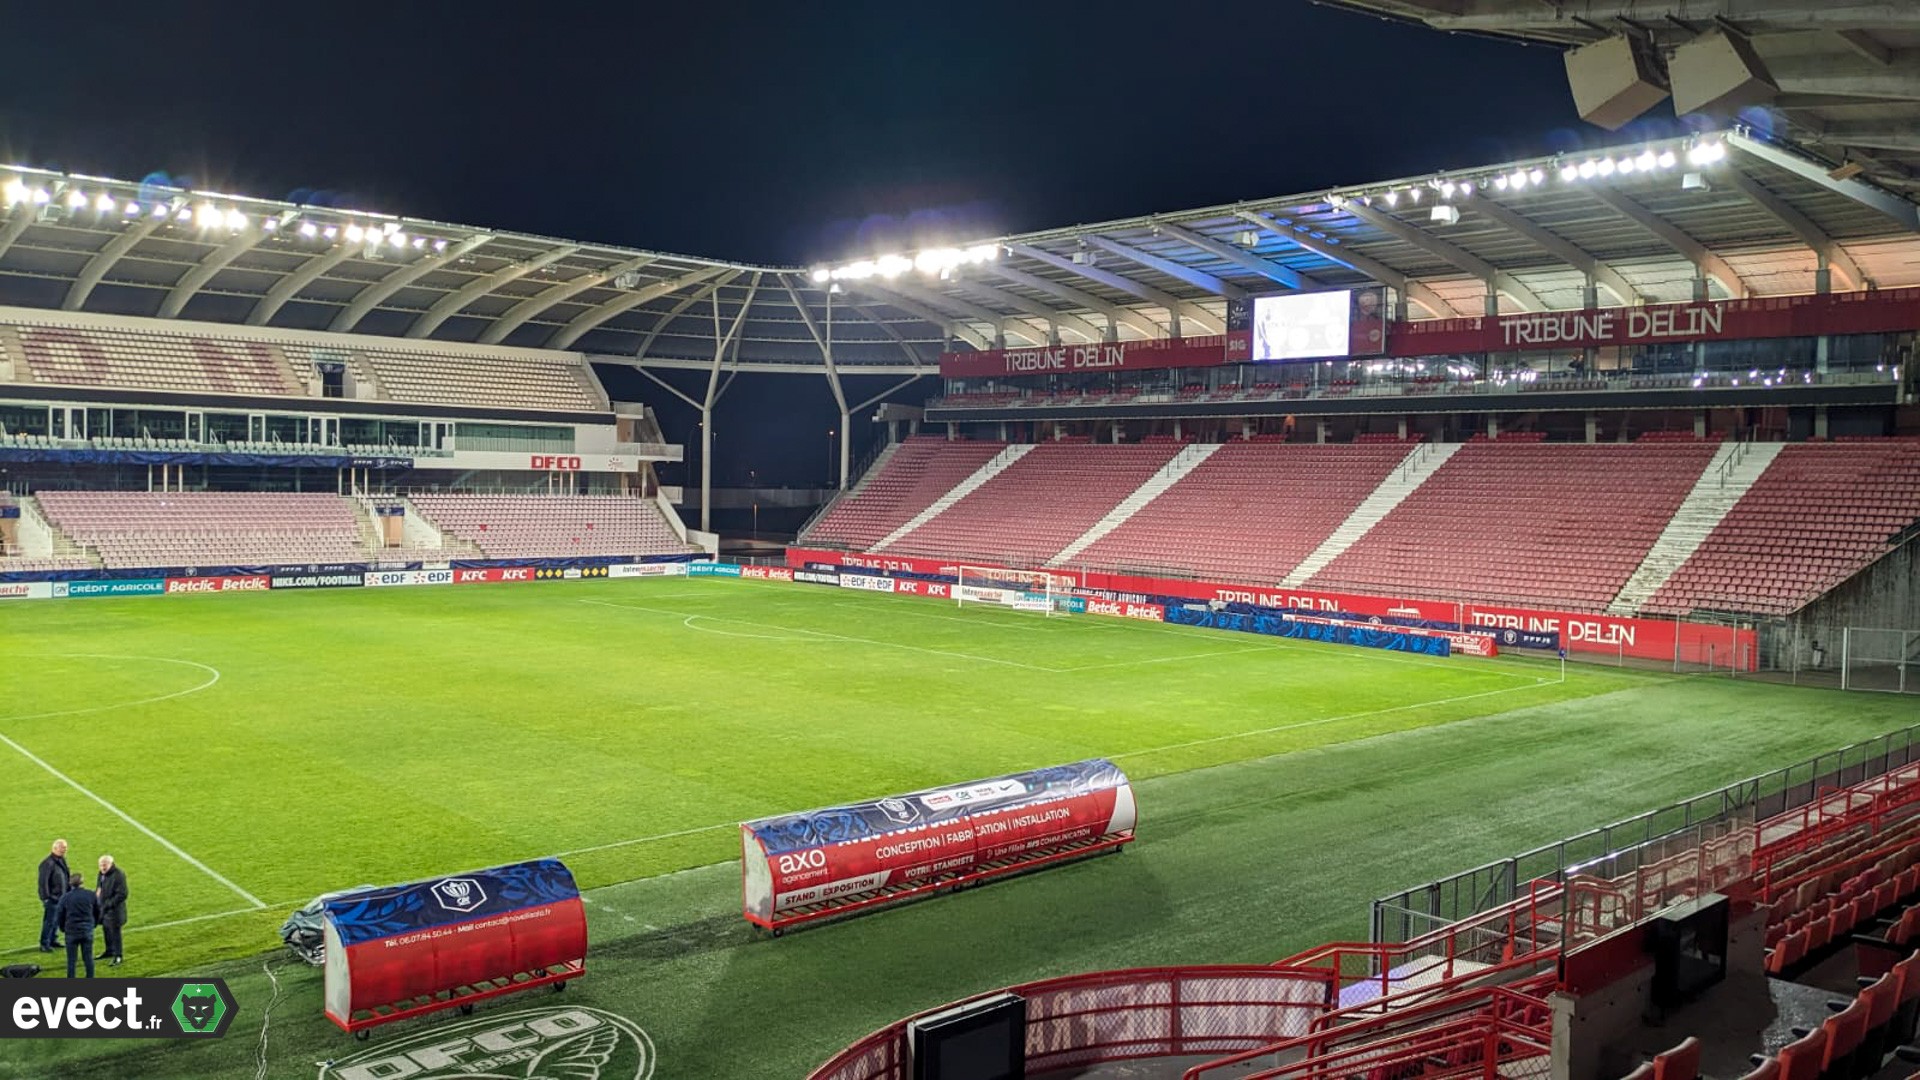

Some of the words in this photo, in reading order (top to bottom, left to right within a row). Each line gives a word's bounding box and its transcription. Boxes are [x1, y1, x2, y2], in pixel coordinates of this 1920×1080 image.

[1499, 314, 1613, 344] TRIBUNE
[1628, 306, 1722, 338] DELIN
[1003, 349, 1066, 371] TRIBUNE
[1074, 345, 1124, 367] DELIN
[530, 456, 581, 469] DFCO
[461, 570, 488, 581] KFC
[502, 569, 528, 580] KFC
[69, 582, 107, 594] CRÉDIT
[111, 582, 163, 592] AGRICOLE
[169, 579, 216, 593] Betclic
[221, 577, 267, 591] Betclic
[899, 582, 917, 592] KFC
[927, 584, 946, 595] KFC
[1088, 601, 1122, 615] Betclic
[1126, 604, 1161, 619] Betclic
[1568, 620, 1635, 646] DELIN
[875, 837, 941, 859] CONCEPTION
[947, 821, 1007, 845] FABRICATION
[1013, 808, 1070, 830] INSTALLATION
[779, 849, 826, 874] axo
[904, 865, 931, 877] VOTRE
[933, 854, 975, 873] STANDISTE
[782, 867, 828, 884] agencement
[785, 891, 815, 905] STAND
[823, 878, 874, 896] EXPOSITION
[460, 1048, 538, 1074] 1998
